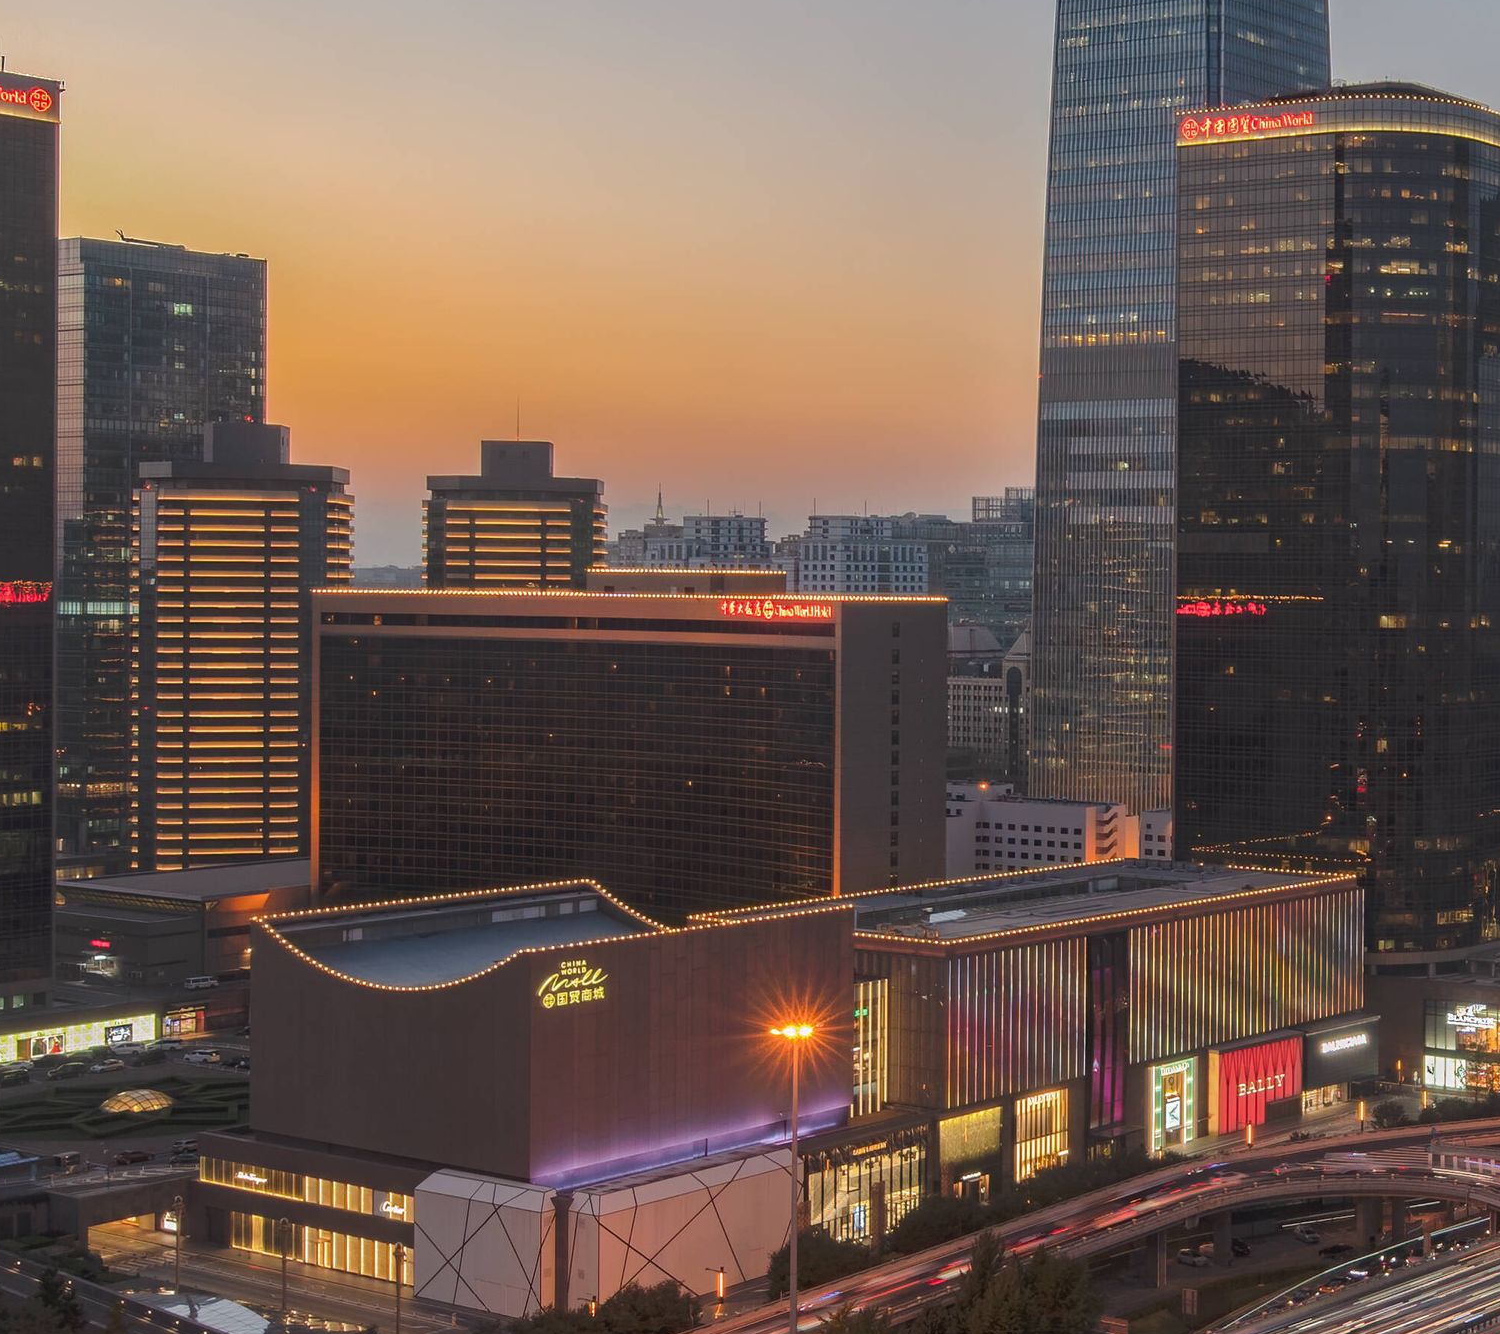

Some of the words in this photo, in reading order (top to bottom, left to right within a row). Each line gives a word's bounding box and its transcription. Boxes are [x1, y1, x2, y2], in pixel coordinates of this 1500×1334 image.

[1251, 115, 1282, 131] China
[1282, 112, 1313, 126] World
[561, 959, 587, 969] CHINA
[561, 967, 587, 976] WORLD
[538, 968, 609, 997] Mall
[556, 985, 605, 1006] 国贸商城
[1237, 1073, 1285, 1097] BALLY
